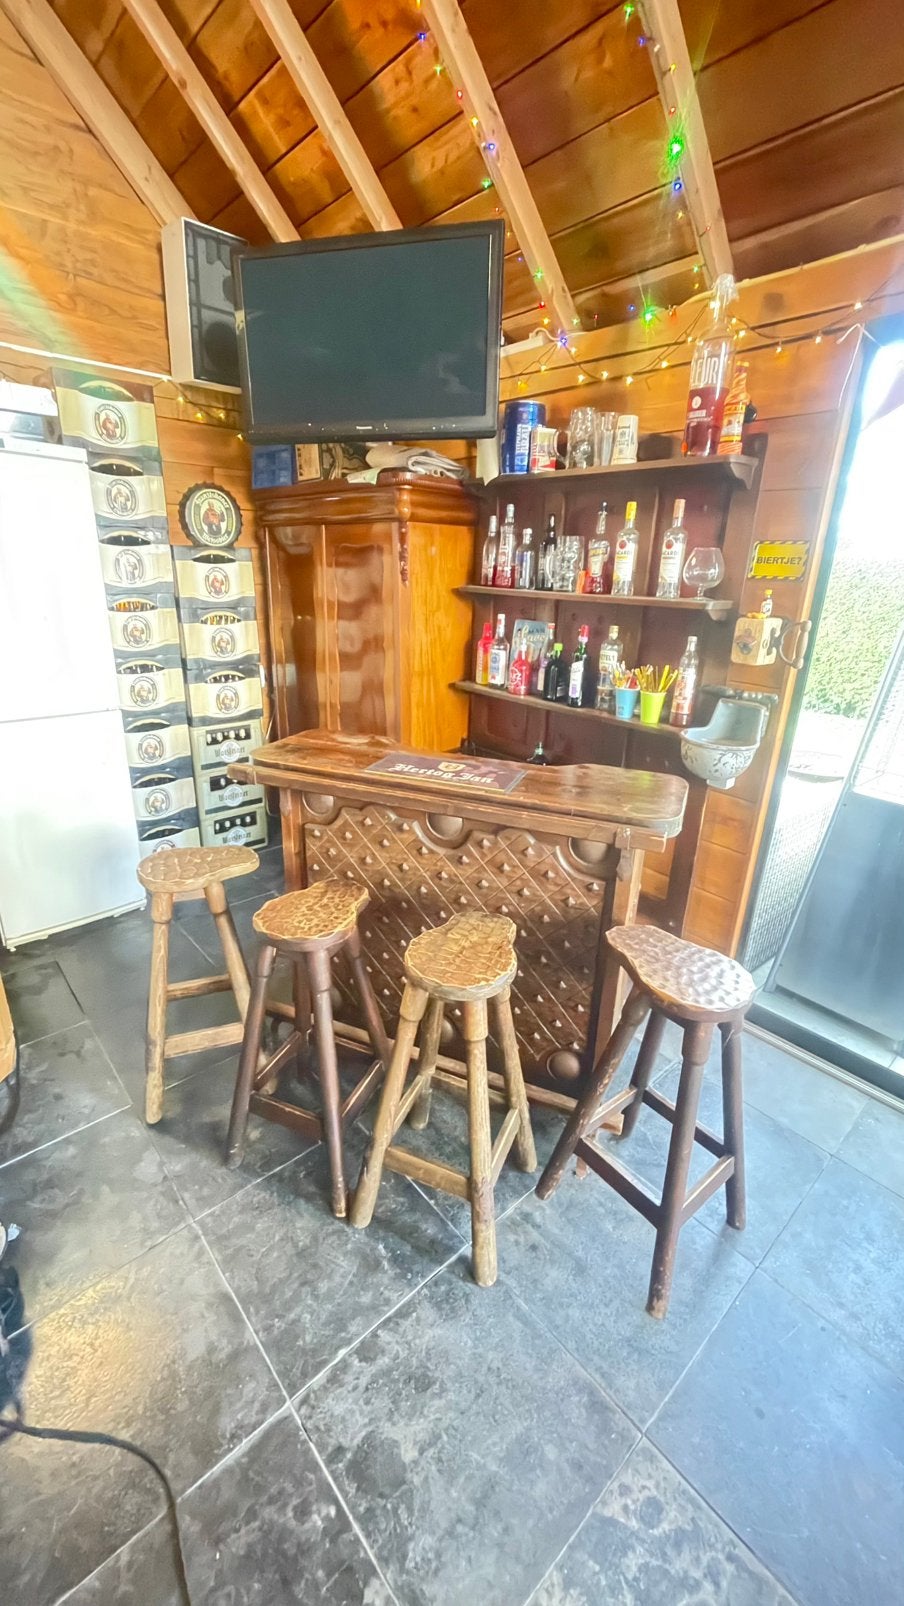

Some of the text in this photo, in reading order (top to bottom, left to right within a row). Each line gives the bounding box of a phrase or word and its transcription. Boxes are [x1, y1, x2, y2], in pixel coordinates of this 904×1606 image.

[756, 556, 802, 565] BIERTJE?
[386, 763, 495, 784] Hertog Jan
